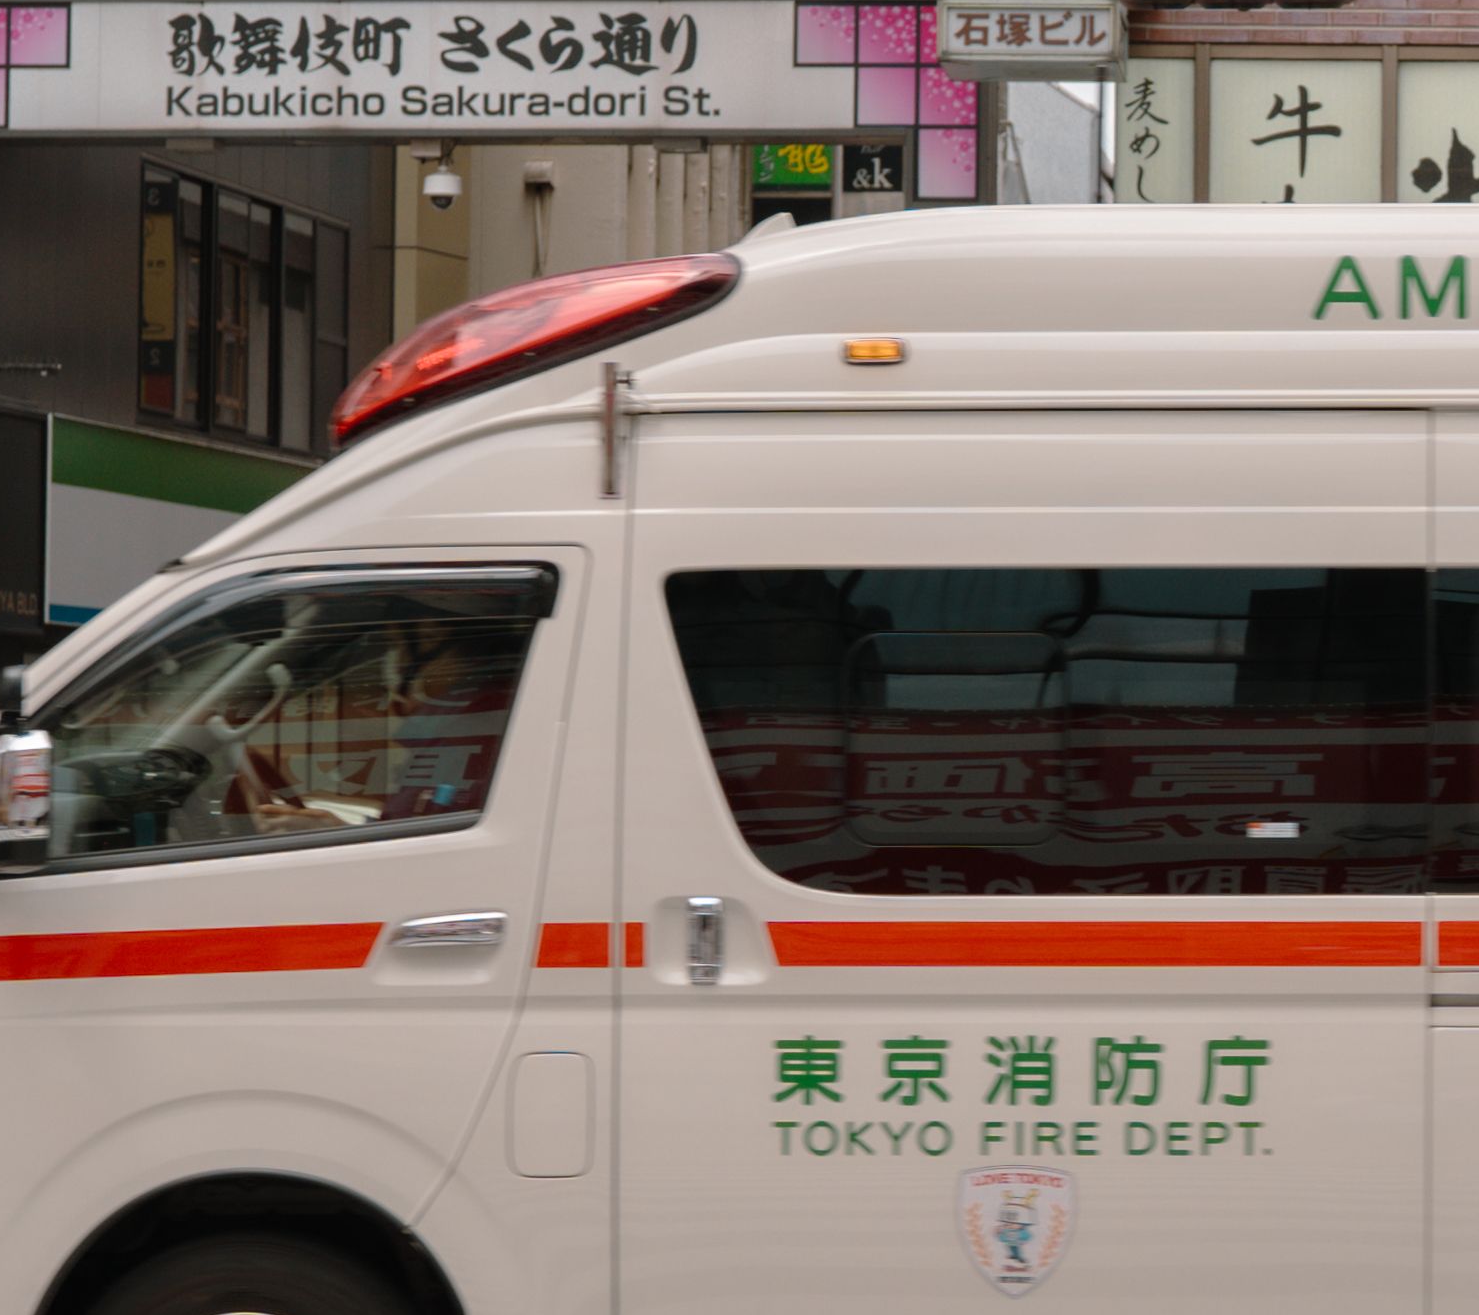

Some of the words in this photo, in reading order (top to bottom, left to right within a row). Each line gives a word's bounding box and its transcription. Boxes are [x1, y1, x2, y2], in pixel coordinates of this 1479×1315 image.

[166, 12, 411, 79] 歌舞伎町
[437, 11, 701, 75] さくら通り
[954, 12, 1108, 48] 石塚ビル
[166, 85, 387, 118] Kabukicho
[400, 85, 648, 118] Sakura-dori
[661, 85, 722, 118] St.
[772, 1034, 1271, 1107] 東京消防庁
[772, 1120, 954, 1157] TOKYO
[979, 1120, 1101, 1157] FIRE
[1124, 1120, 1274, 1157] DEPT.
